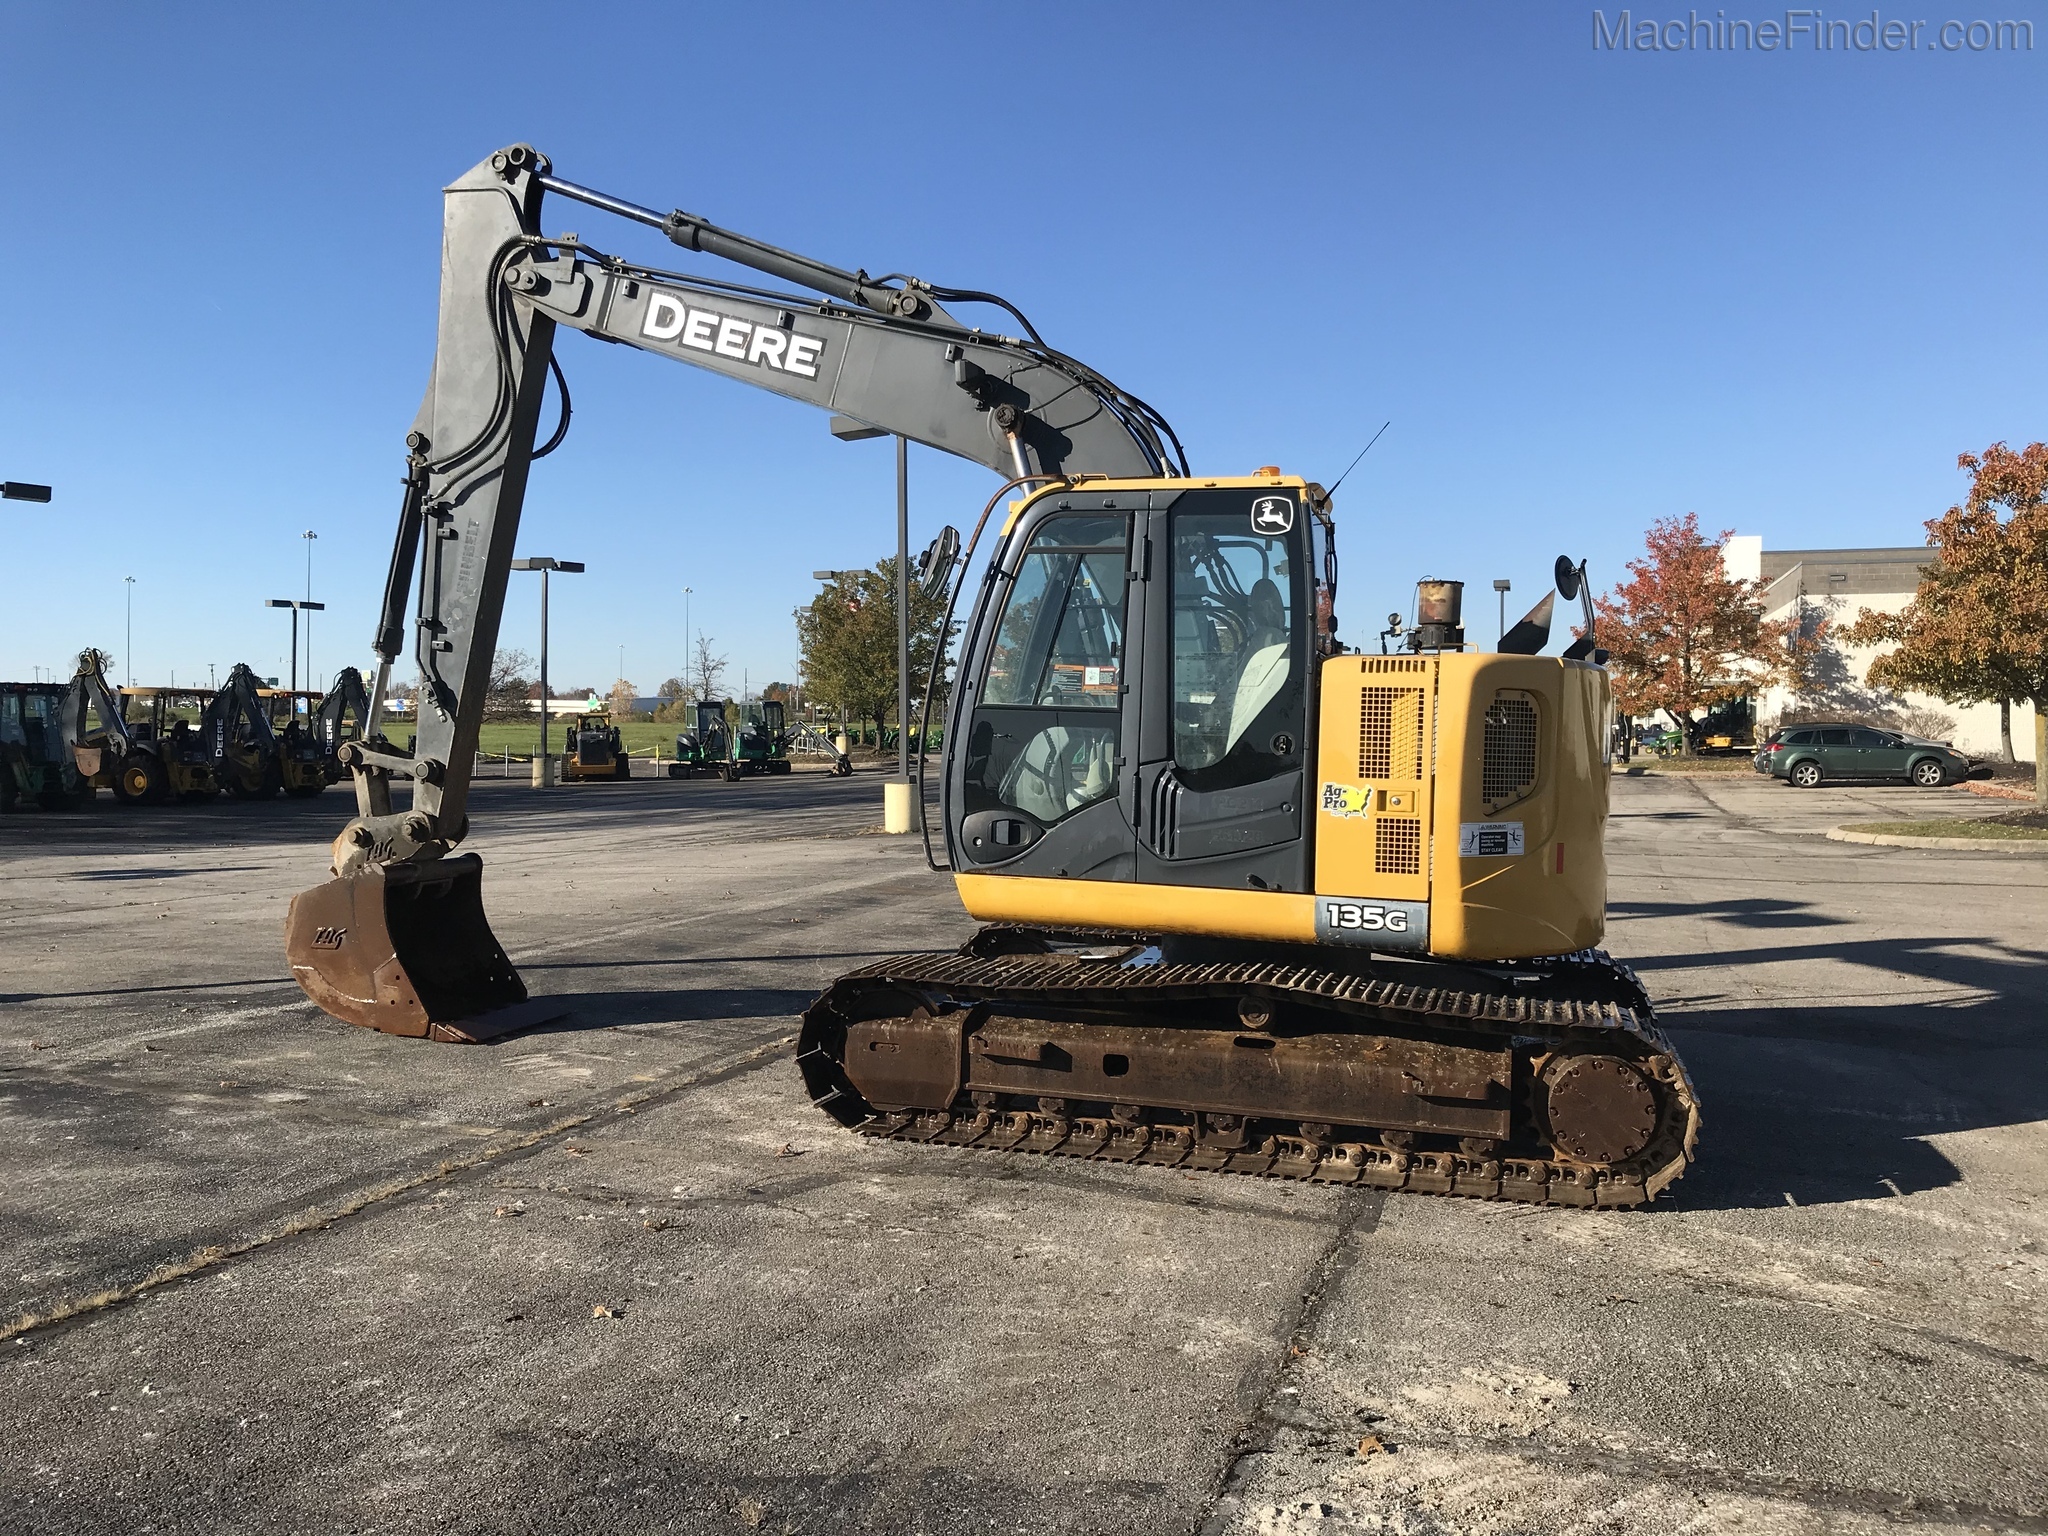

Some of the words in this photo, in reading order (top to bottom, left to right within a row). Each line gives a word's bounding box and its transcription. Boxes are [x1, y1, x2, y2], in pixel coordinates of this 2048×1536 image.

[642, 292, 823, 377] DEERE
[214, 718, 224, 758] DEERE
[325, 718, 334, 755] DEERE
[1323, 785, 1347, 799] Ag-
[1323, 797, 1347, 808] Pro
[1327, 902, 1408, 932] 135G
